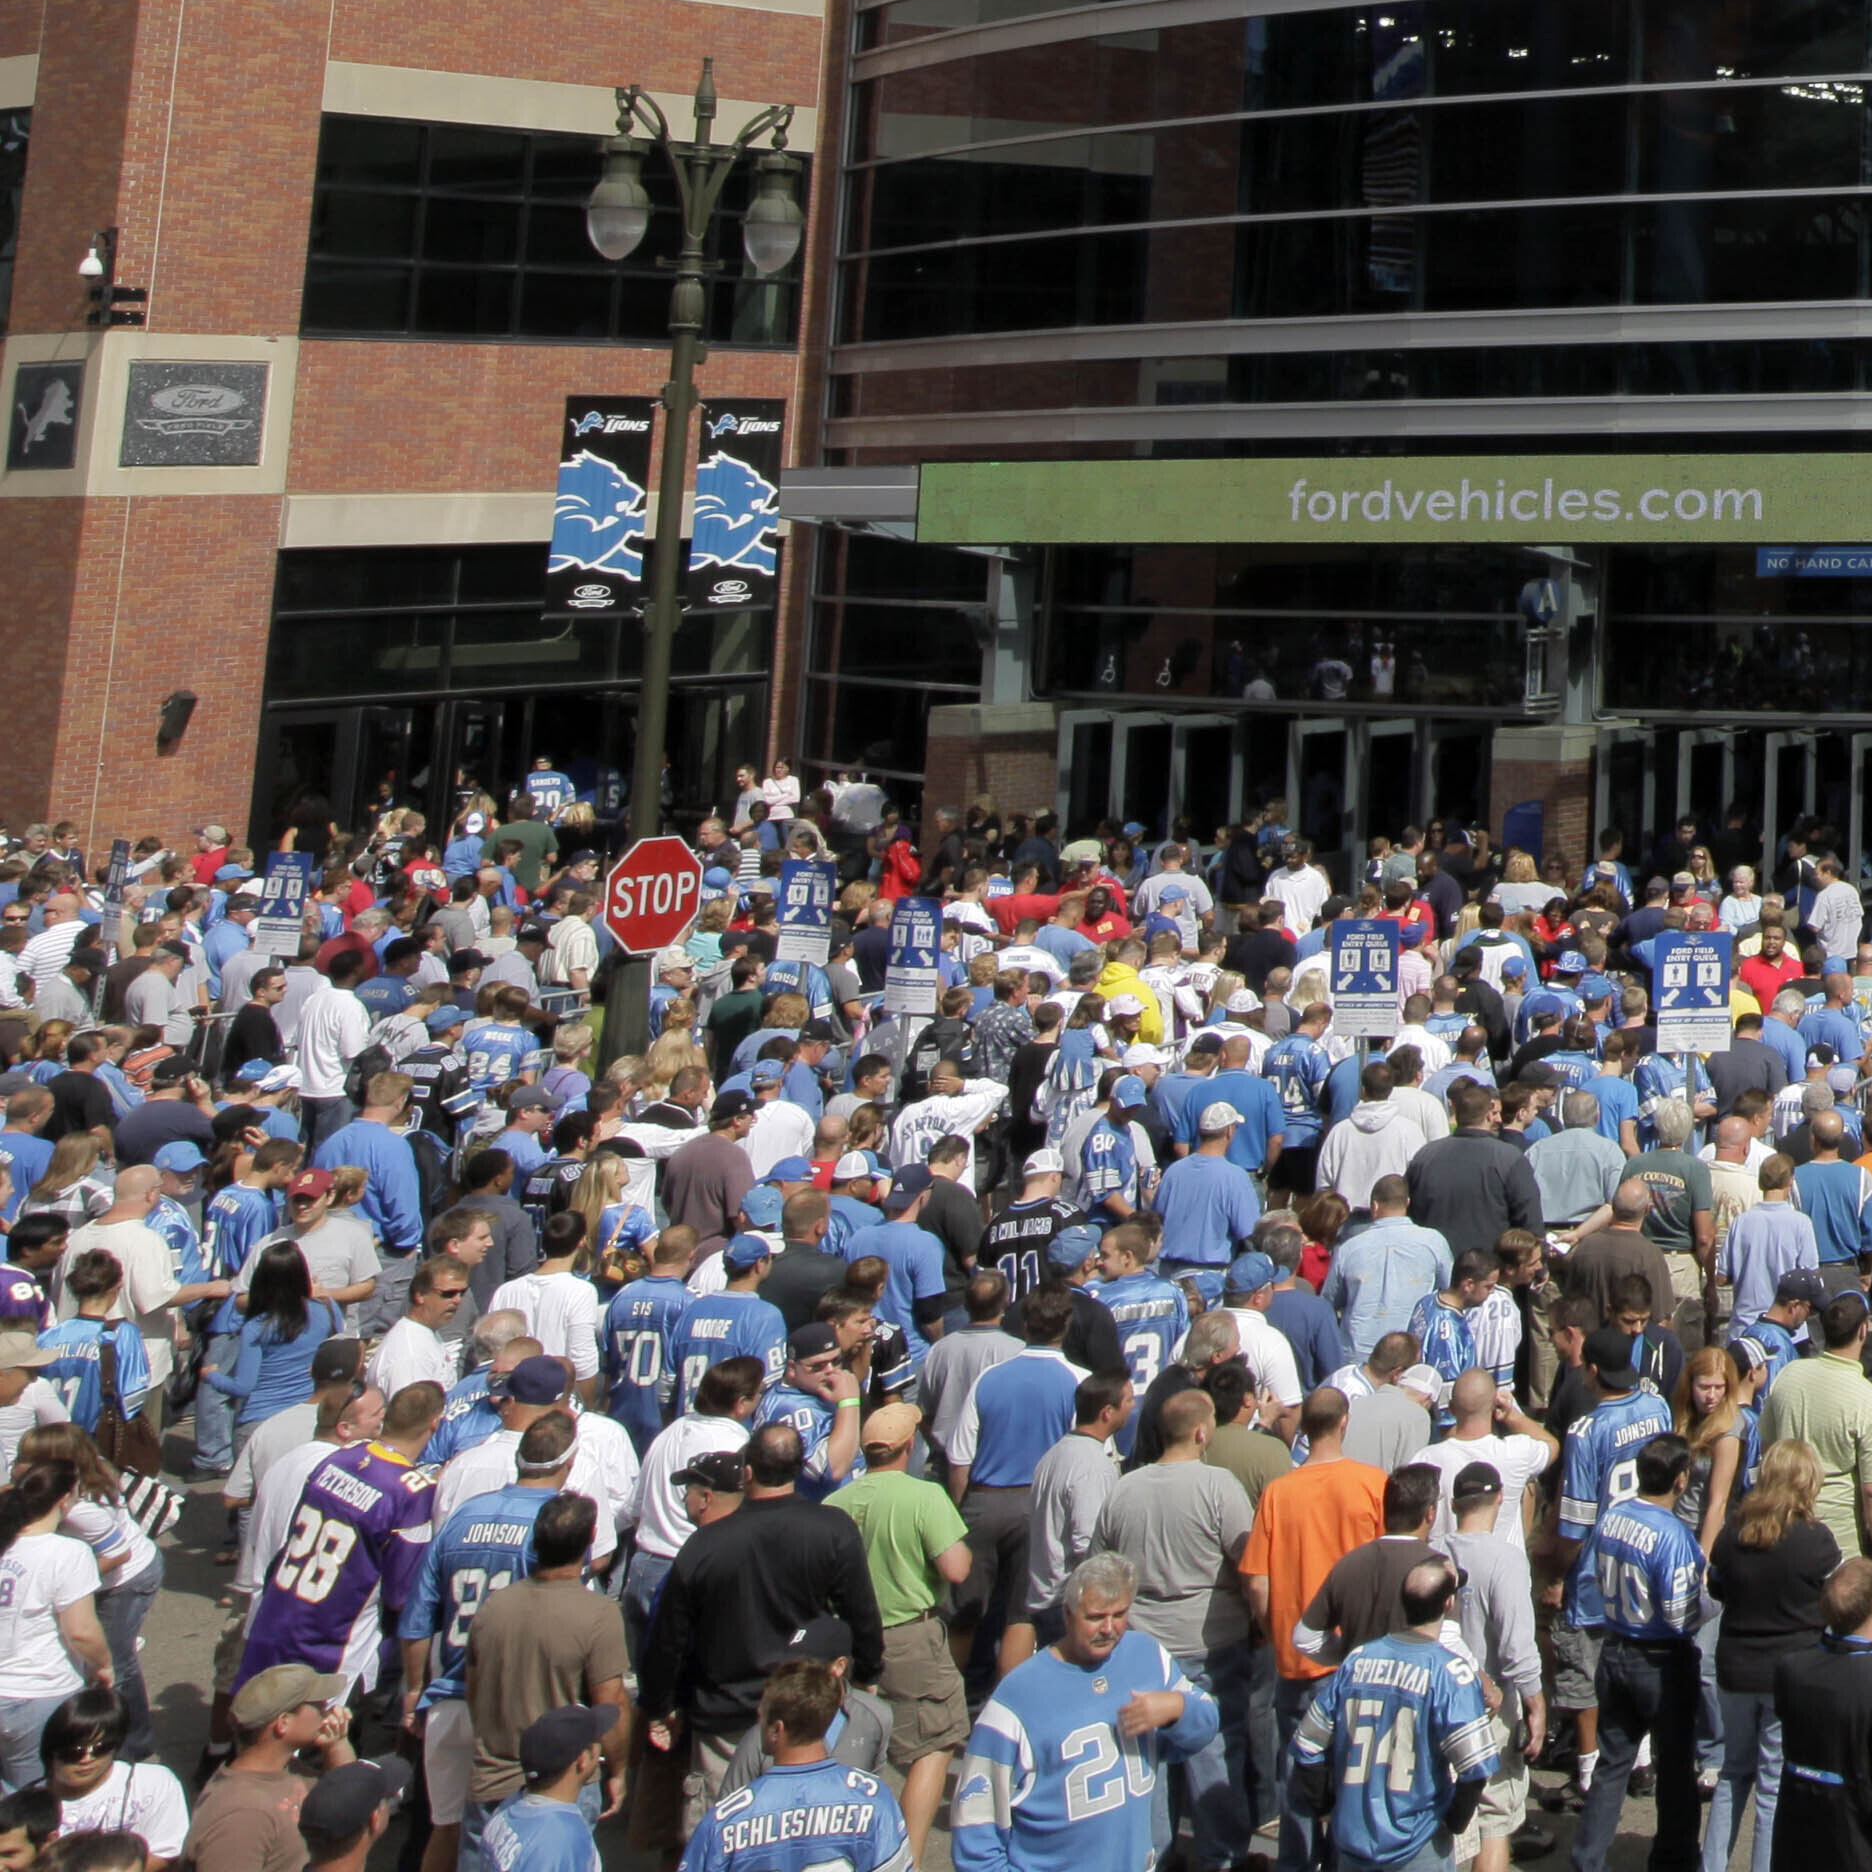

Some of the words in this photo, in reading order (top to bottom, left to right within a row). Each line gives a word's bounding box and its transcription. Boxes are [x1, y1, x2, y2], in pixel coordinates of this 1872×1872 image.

[171, 388, 226, 409] Ford
[603, 420, 650, 434] LIONS
[737, 420, 782, 435] LIONS
[1289, 479, 1764, 522] fordvehicles.com
[1767, 558, 1788, 568] NO
[1796, 558, 1841, 569] HAND
[1537, 581, 1558, 613] A
[613, 871, 696, 919] STOP
[1092, 1133, 1116, 1153] 80
[1643, 1170, 1685, 1188] COUNTRY
[997, 1250, 1040, 1304] 11
[1488, 1300, 1512, 1321] 26
[691, 1318, 733, 1339] MOORE
[275, 1503, 357, 1604] 28
[1351, 1657, 1430, 1693] SPIELMAN
[1446, 1657, 1475, 1683] 5
[1343, 1697, 1416, 1792] 54
[723, 1804, 873, 1853] SCHLESINGER
